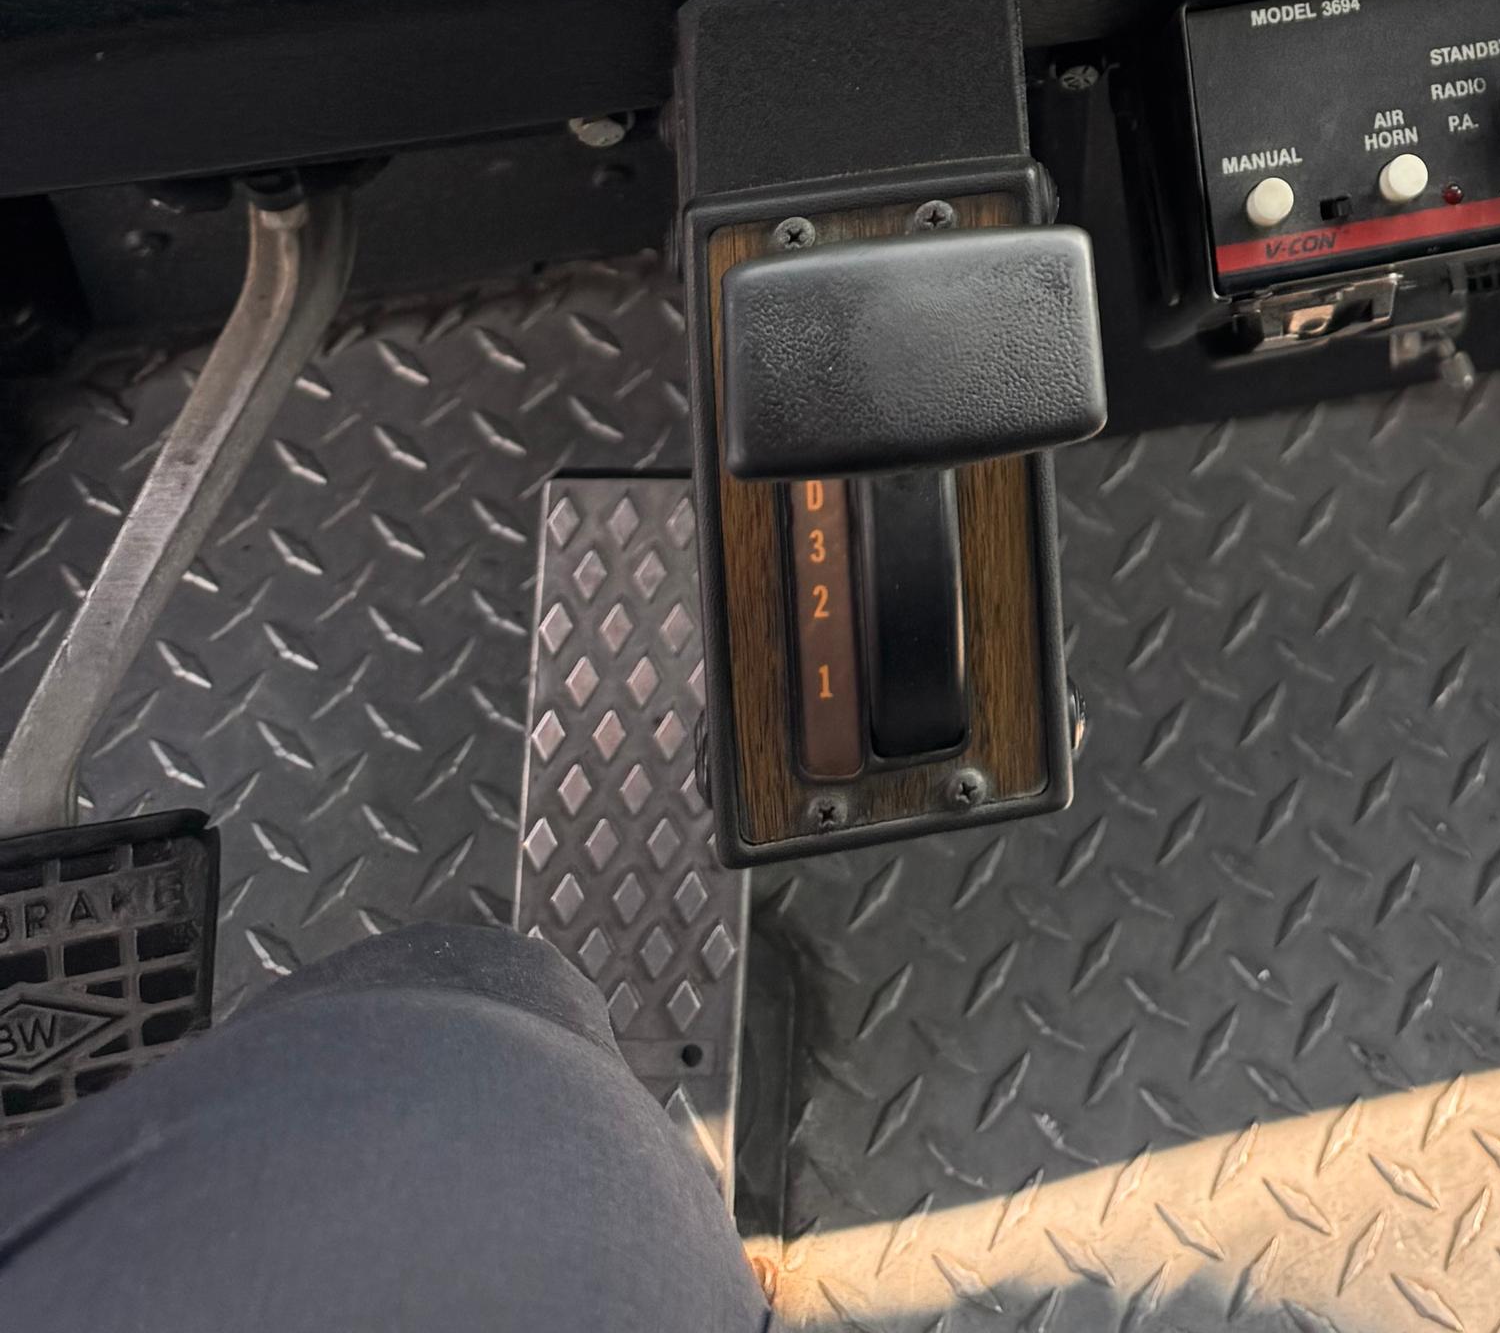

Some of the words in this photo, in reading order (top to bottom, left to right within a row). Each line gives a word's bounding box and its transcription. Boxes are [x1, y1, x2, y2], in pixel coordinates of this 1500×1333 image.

[1251, 2, 1317, 26] MODEL
[1430, 77, 1487, 100] RADIO
[1373, 109, 1404, 129] AIR
[1448, 113, 1479, 133] P.A.
[1364, 126, 1419, 152] HORN
[1222, 147, 1303, 175] MANUAL
[1265, 232, 1337, 259] V-CON
[807, 480, 824, 511] D
[809, 529, 826, 563] 3
[812, 585, 830, 617] 2
[818, 664, 833, 698] 1
